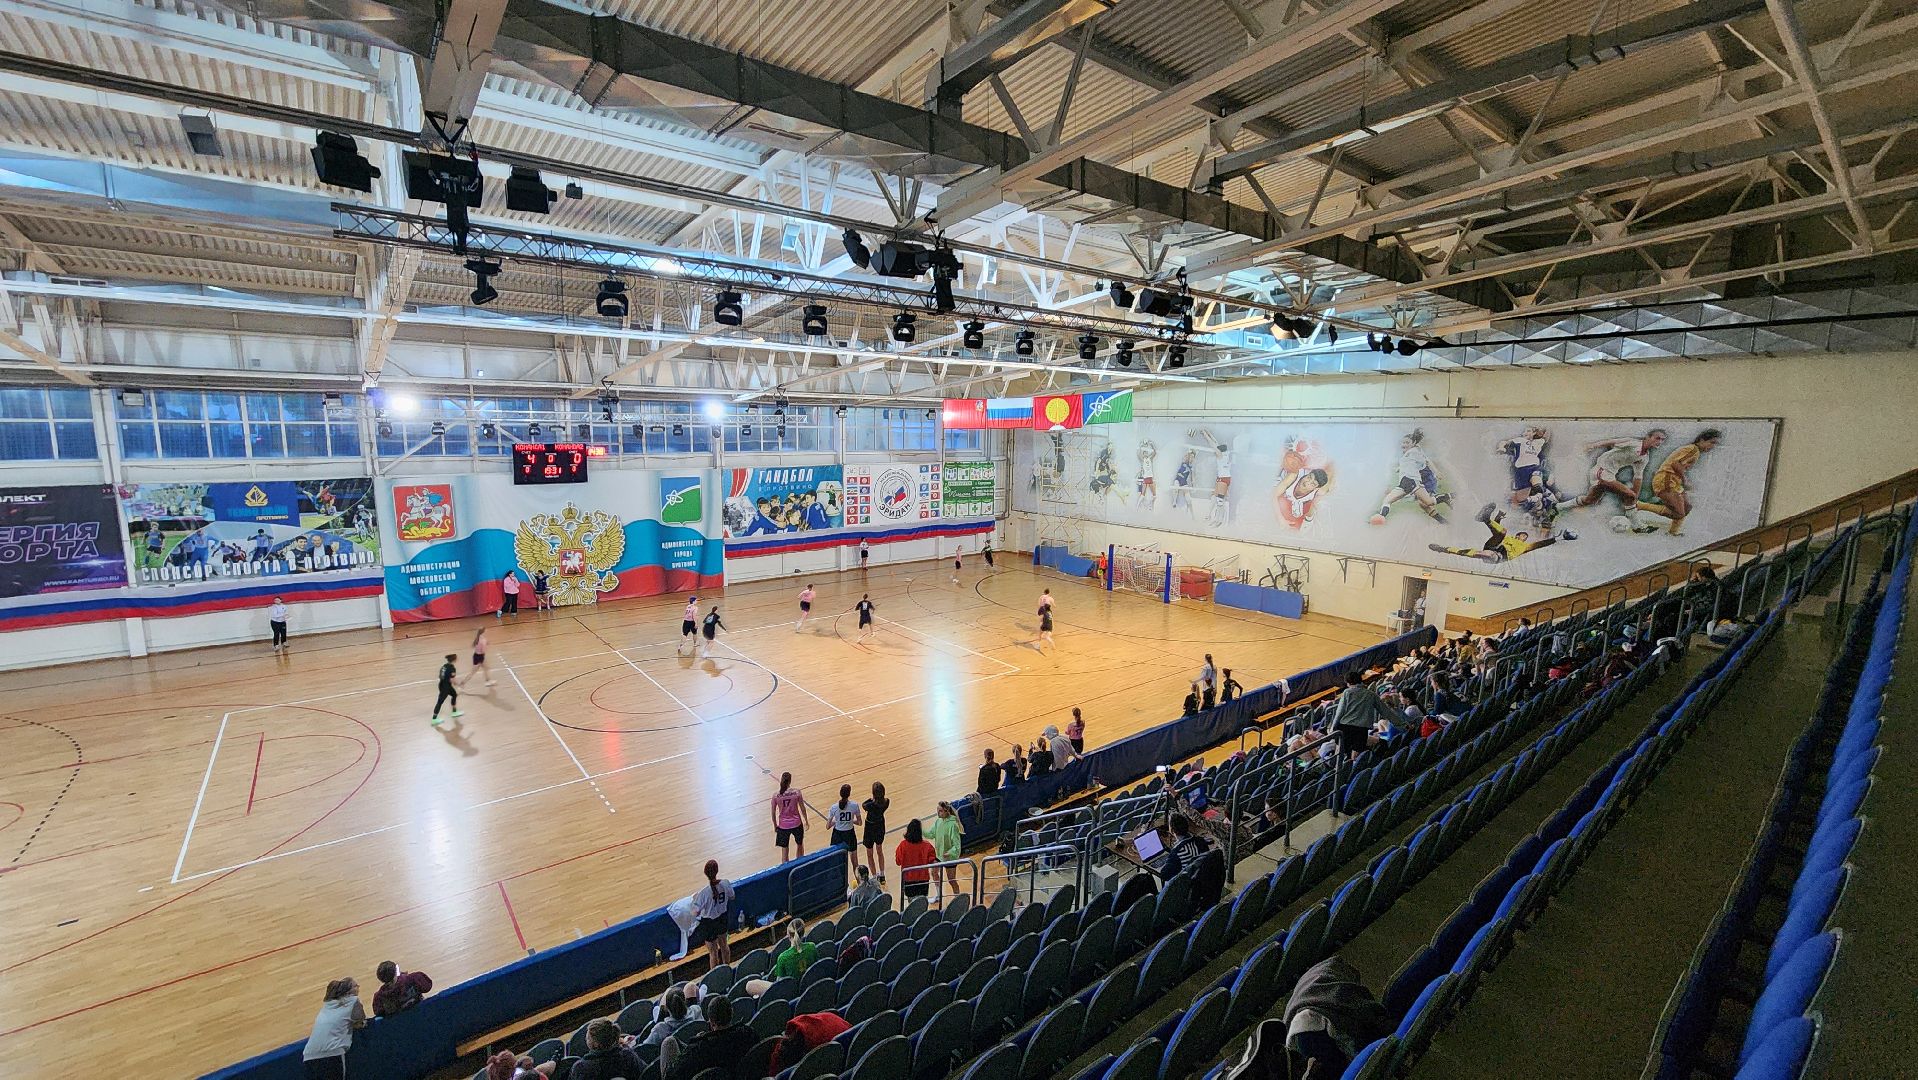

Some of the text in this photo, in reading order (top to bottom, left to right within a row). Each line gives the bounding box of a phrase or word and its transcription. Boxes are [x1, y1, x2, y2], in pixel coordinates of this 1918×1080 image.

[527, 454, 535, 464] 4
[548, 454, 554, 463] 0
[574, 453, 581, 463] 0
[758, 468, 813, 485] ГАНДБОЛ
[765, 484, 813, 492] ПРОТВИНО
[0, 494, 46, 502] ЛЕКТ
[879, 503, 910, 518] ЭРИДАН
[142, 550, 375, 582] СПОНСОР СПОРТА В ПРОТВИНО
[400, 561, 460, 573] АДМИНИСТРАЦИЯ
[409, 572, 456, 584] МОСКОВСКОЙ
[419, 586, 450, 596] ОБЛАСТИ
[782, 798, 791, 807] 17
[839, 812, 851, 821] 20
